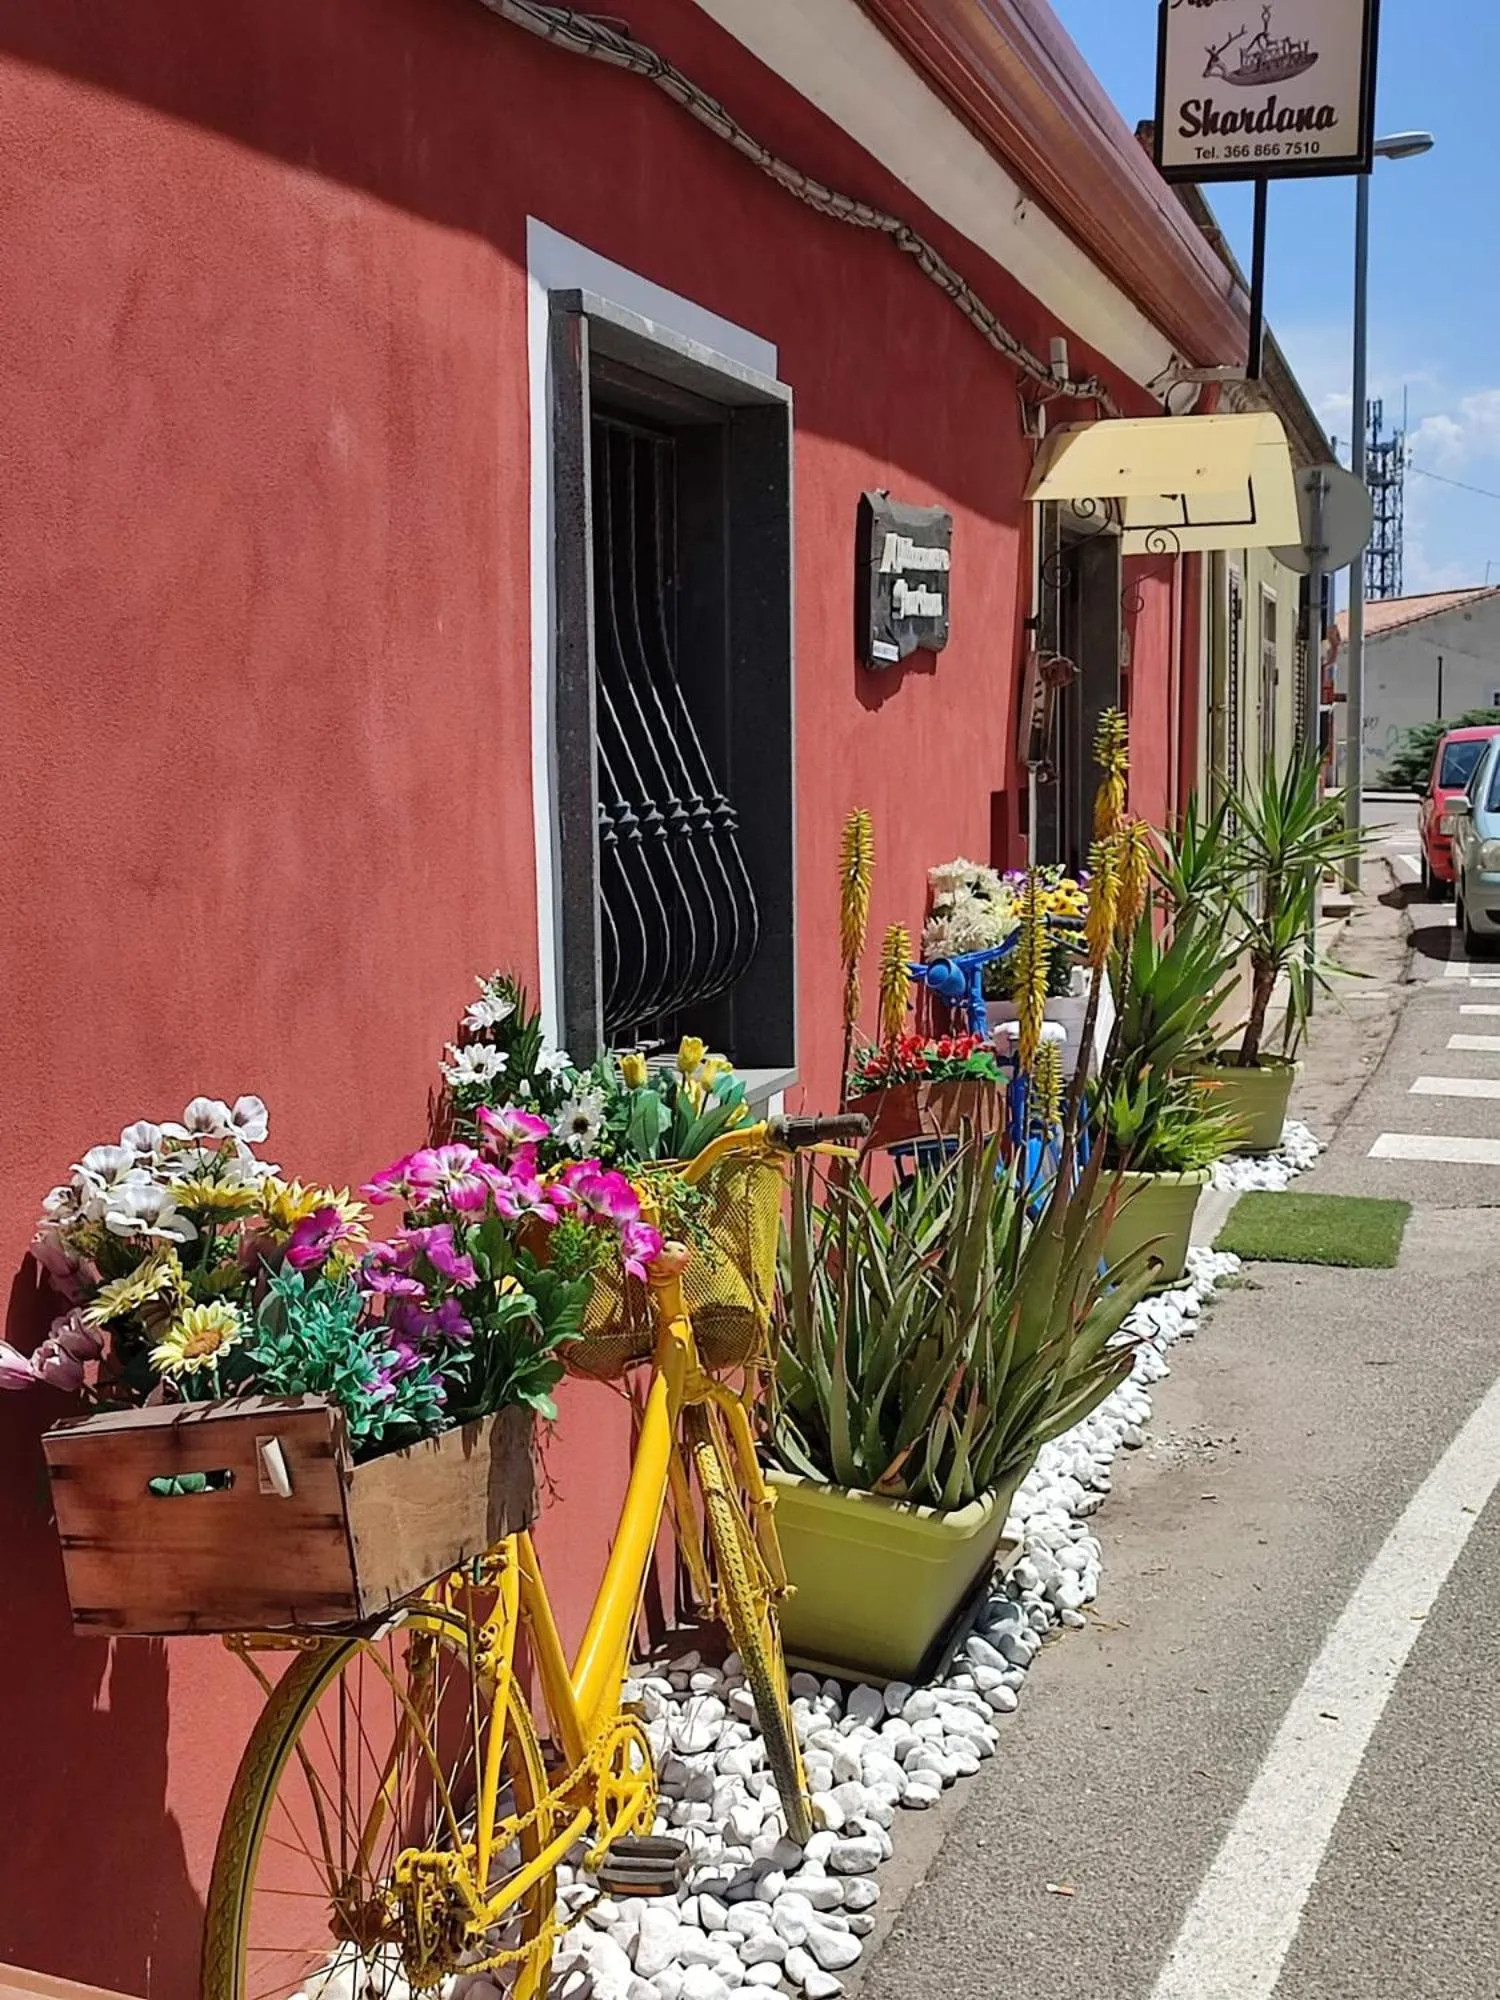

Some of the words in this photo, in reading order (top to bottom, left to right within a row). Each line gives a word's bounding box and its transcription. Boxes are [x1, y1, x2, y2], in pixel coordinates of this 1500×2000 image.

[1178, 95, 1338, 138] Shardana
[1195, 147, 1218, 160] Tel.
[1224, 145, 1250, 159] 366
[1254, 143, 1281, 157] 866
[1286, 141, 1320, 155] 7510
